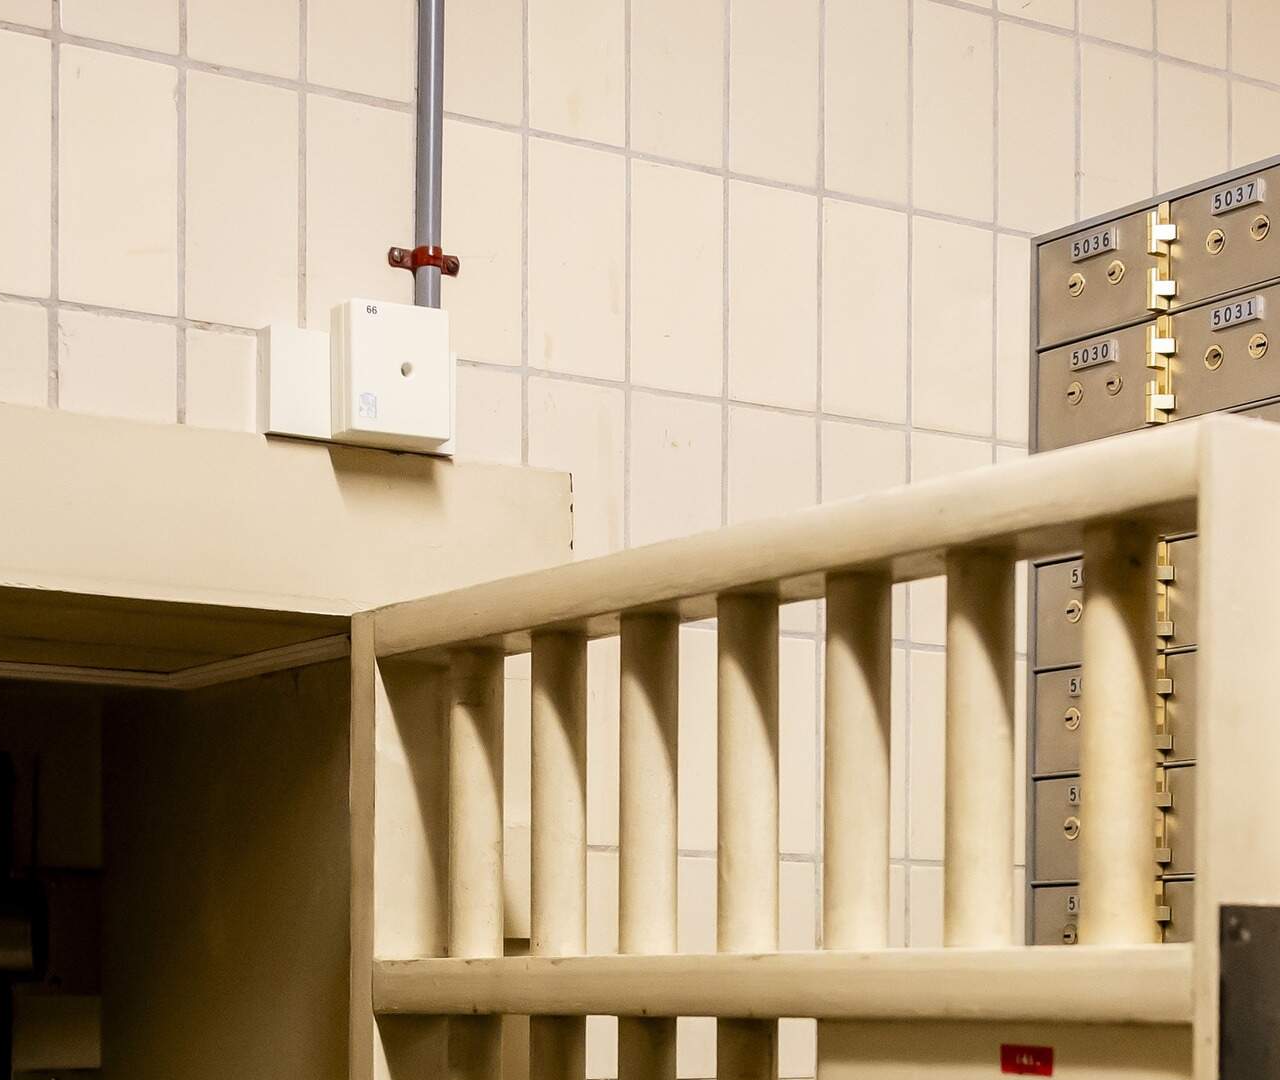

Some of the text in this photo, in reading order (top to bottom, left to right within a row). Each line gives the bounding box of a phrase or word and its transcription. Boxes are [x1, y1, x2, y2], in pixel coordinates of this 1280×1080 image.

[1214, 183, 1256, 209] 5037
[1073, 234, 1110, 257] 5036
[366, 305, 377, 314] 66
[1213, 302, 1255, 325] 5031
[1072, 344, 1110, 366] 5030
